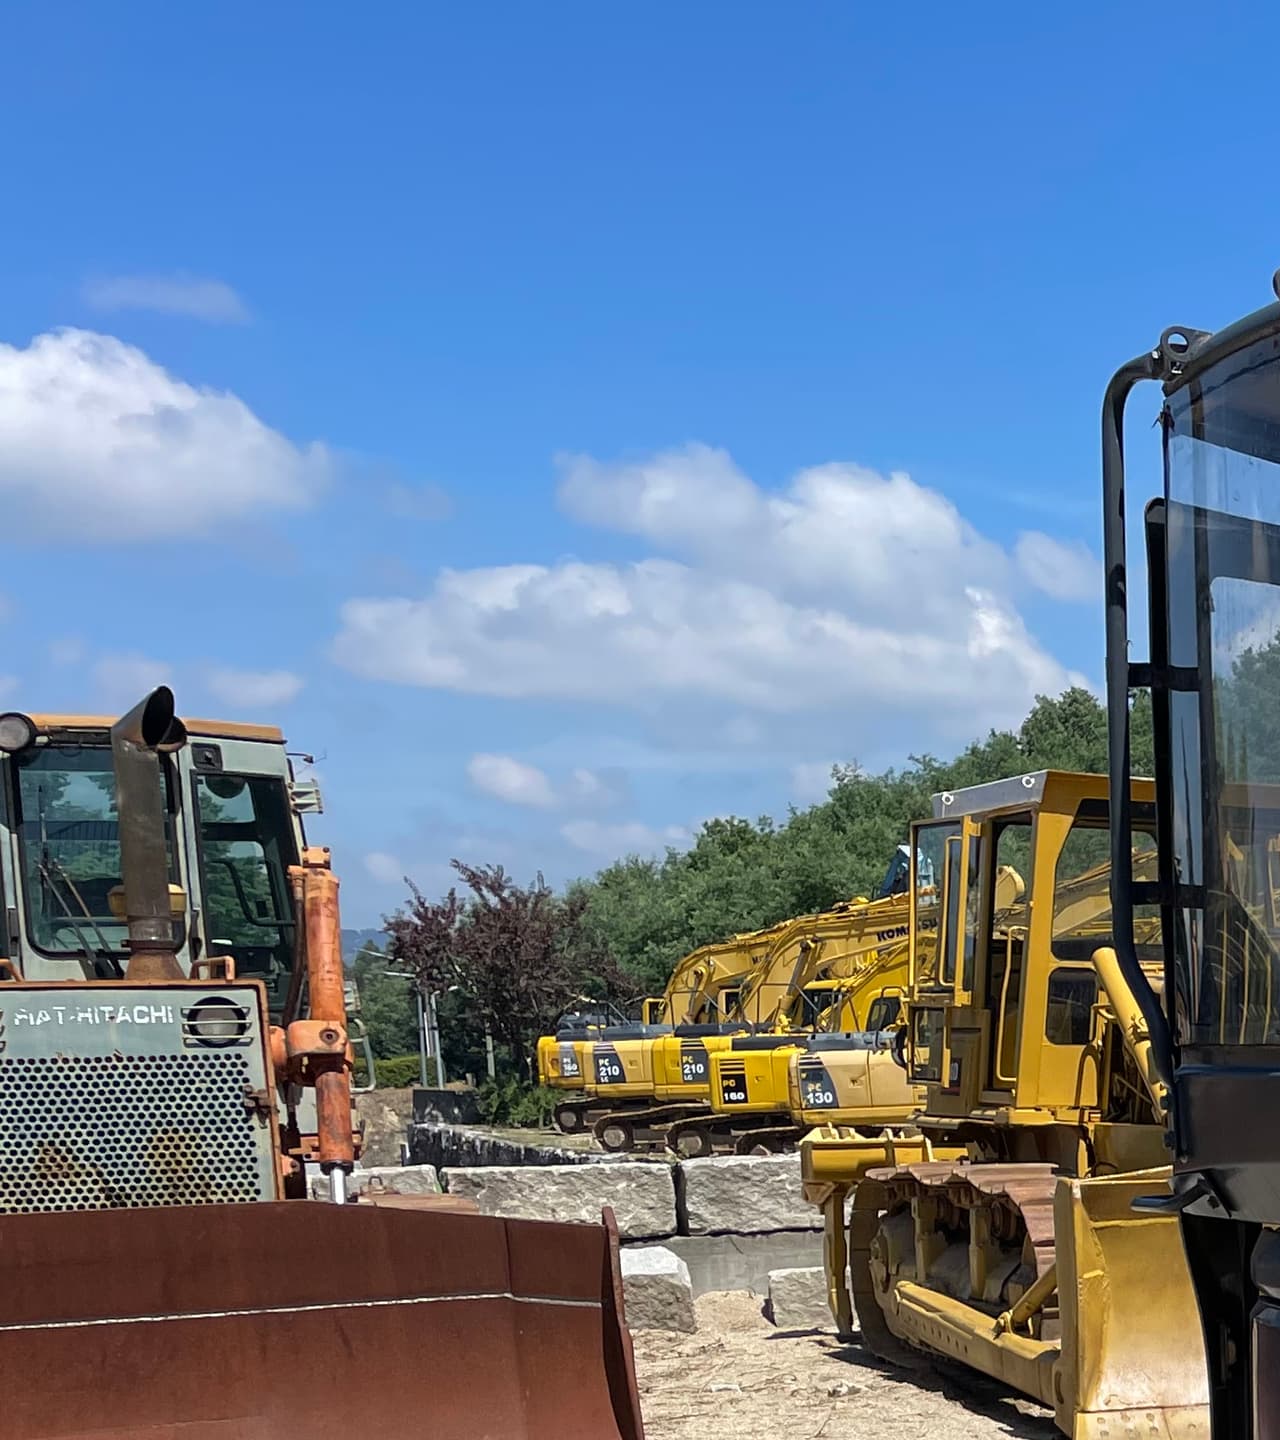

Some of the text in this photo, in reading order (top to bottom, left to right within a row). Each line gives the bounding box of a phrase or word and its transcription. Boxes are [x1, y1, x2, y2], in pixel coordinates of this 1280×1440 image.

[599, 1058, 610, 1066] PC
[600, 1065, 620, 1076] 210
[683, 1064, 705, 1074] 210
[722, 1079, 736, 1087] PC
[807, 1083, 822, 1092] PC
[807, 1092, 834, 1104] 130
